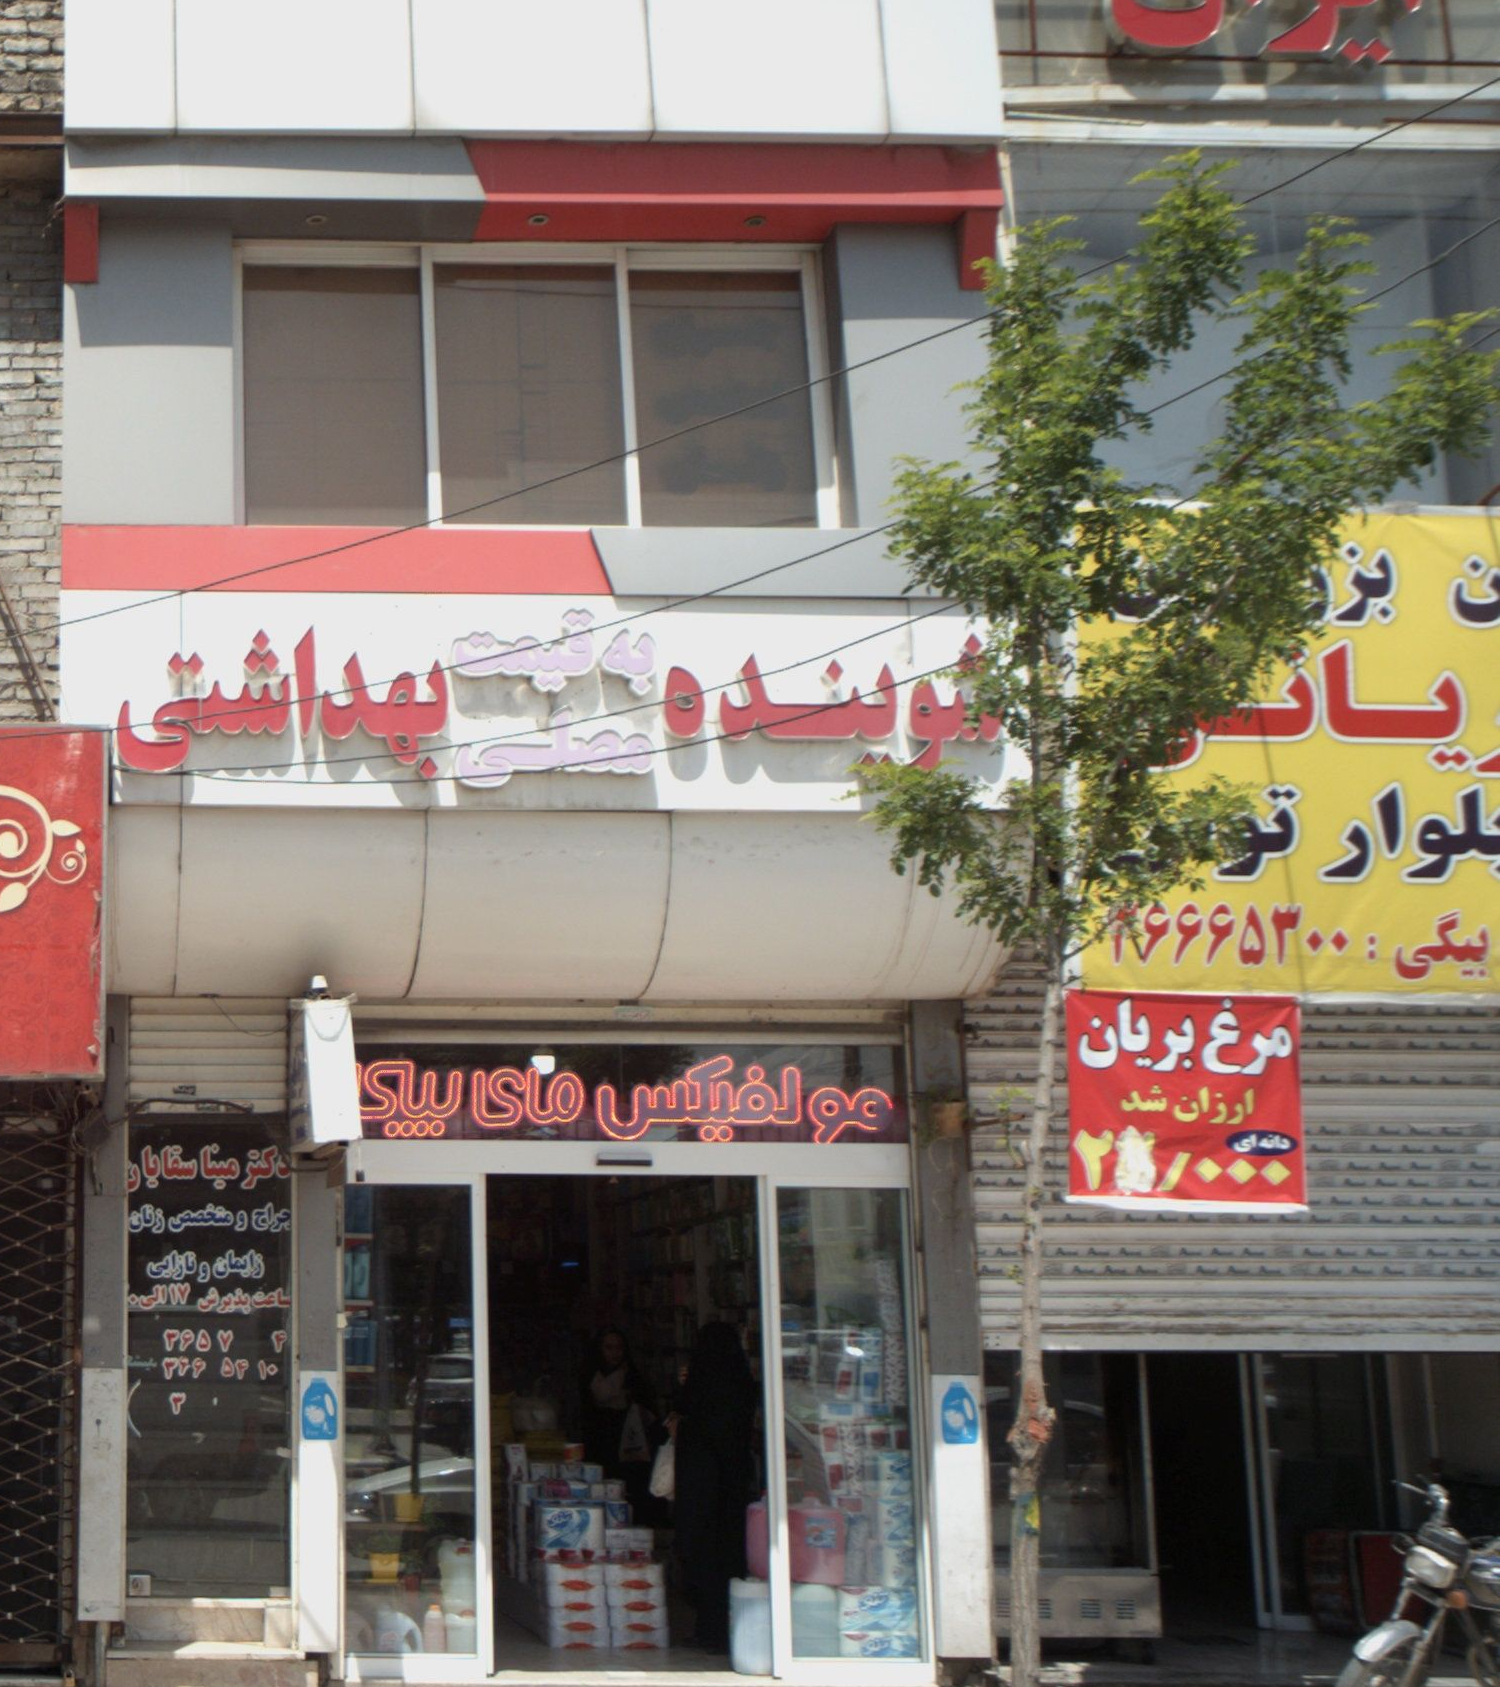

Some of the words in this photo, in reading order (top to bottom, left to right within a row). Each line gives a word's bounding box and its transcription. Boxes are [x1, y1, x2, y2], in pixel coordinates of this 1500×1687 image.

[452, 608, 595, 693] قیمت
[602, 628, 656, 696] به
[116, 624, 450, 780] بهداشتی
[455, 704, 654, 788] مصلی
[1319, 782, 1500, 884] لوار
[1077, 996, 1197, 1073] بریان
[1201, 996, 1294, 1076] مرغ
[472, 1065, 585, 1128] مای
[1119, 1083, 1169, 1113] شد
[1172, 1085, 1256, 1126] ارزان
[1232, 1134, 1257, 1154] ای
[1257, 1133, 1293, 1150] دانه
[200, 1142, 241, 1190] مینا
[240, 1145, 292, 1190] دکتر
[128, 1203, 166, 1234] زنان
[168, 1203, 234, 1233] متخصص
[234, 1209, 248, 1232] و
[146, 1249, 198, 1281] نازایی
[197, 1261, 211, 1283] و
[212, 1249, 265, 1279] زایمان
[168, 1282, 191, 1306] ۱۷
[197, 1286, 251, 1315] پذیرش
